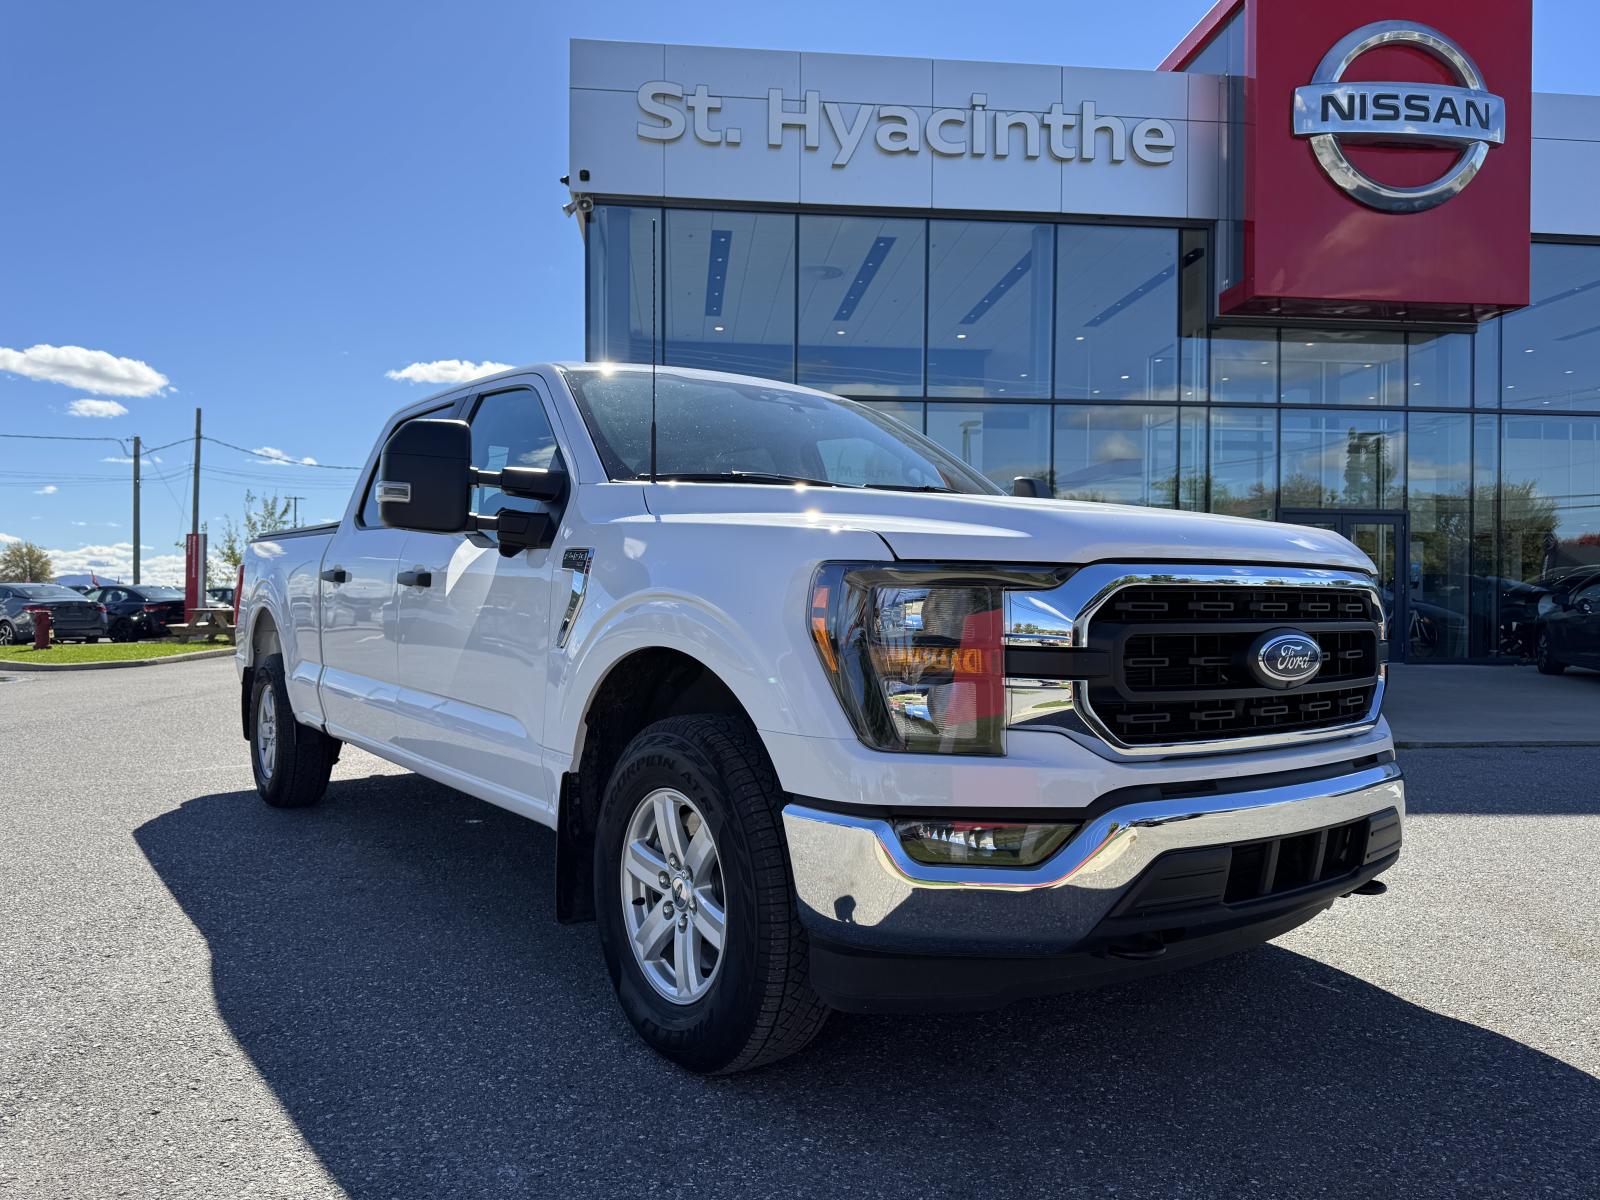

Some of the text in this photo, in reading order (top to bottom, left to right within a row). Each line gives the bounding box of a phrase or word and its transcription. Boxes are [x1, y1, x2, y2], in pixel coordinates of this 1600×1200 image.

[636, 80, 1176, 167] St. Hyacinthe
[1320, 93, 1490, 130] NISSAN
[1277, 644, 1311, 669] Ford
